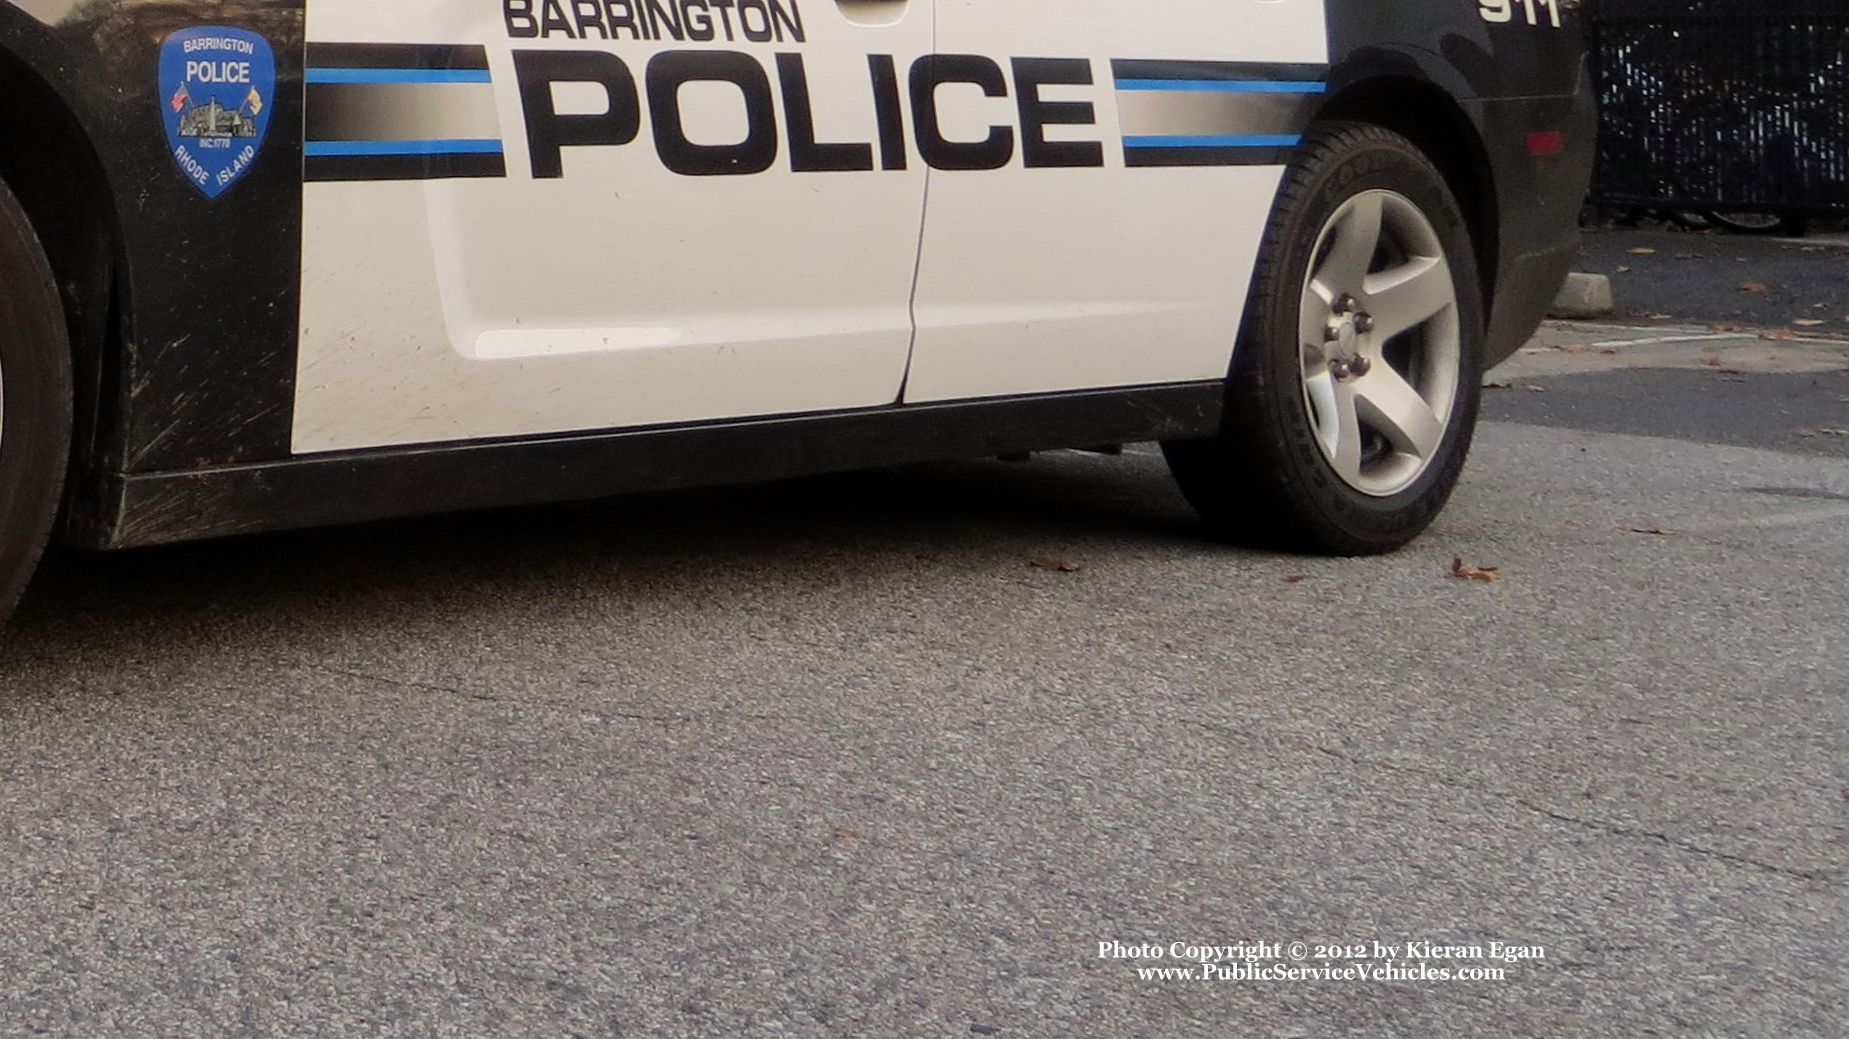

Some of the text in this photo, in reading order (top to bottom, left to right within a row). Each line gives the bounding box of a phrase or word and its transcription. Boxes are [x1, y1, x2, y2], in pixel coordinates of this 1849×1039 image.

[183, 37, 254, 54] BARRINGTON
[186, 61, 251, 83] POLICE
[512, 49, 1105, 179] POLICE
[175, 145, 255, 186] RHODE ISLAND
